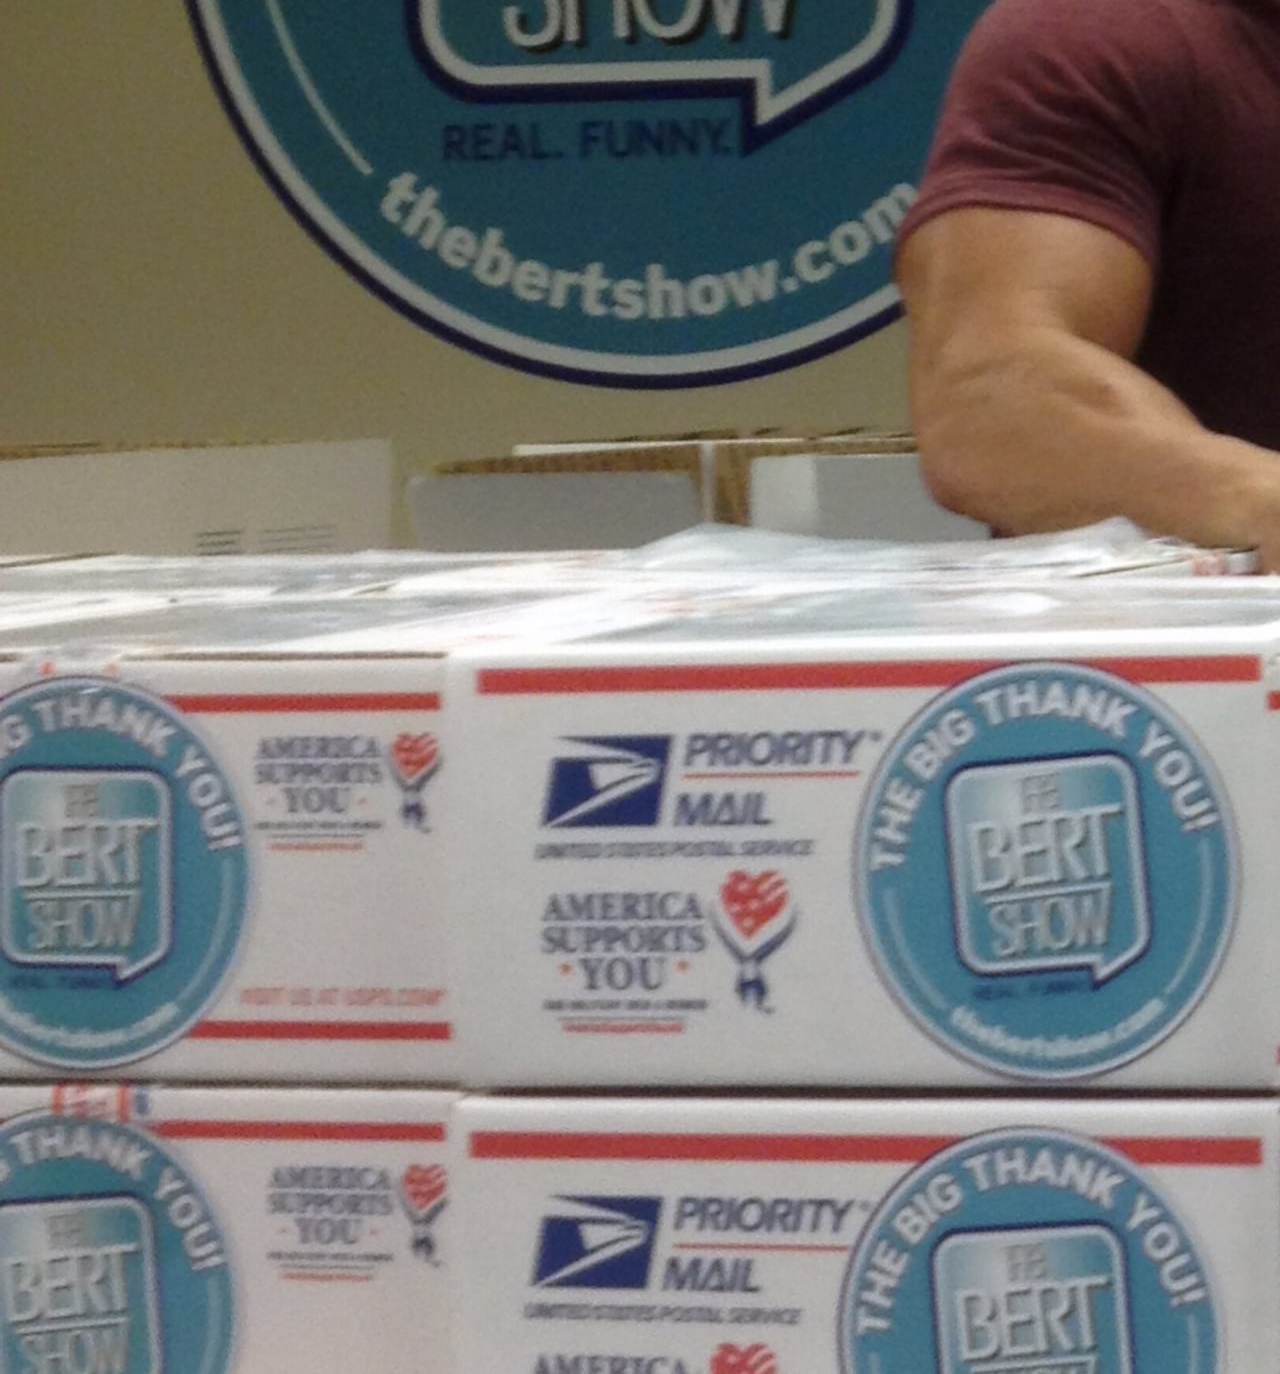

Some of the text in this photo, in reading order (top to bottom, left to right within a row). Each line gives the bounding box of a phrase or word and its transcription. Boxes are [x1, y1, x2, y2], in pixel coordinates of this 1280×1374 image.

[442, 117, 736, 162] REAL. FUNNY.
[381, 169, 919, 321] thebertshow.com
[32, 696, 176, 756] THANK
[174, 746, 244, 852] YOU!
[683, 729, 868, 767] PRIORITY
[871, 779, 925, 872] THE
[904, 708, 975, 781] BIG
[973, 679, 1139, 738] THANK
[1139, 722, 1222, 833] YOU!
[279, 787, 351, 814] YOU
[674, 792, 774, 827] MAIL
[15, 818, 160, 887] BERT
[970, 802, 1125, 892] BERT
[26, 890, 141, 950] SHOW
[543, 892, 703, 921] AMERICA
[989, 885, 1113, 957] SHOW
[541, 925, 707, 954] SUPPORTS
[578, 957, 668, 991] YOU
[9, 1126, 152, 1182] THANK
[155, 1168, 228, 1272] YOU!
[673, 1196, 856, 1234] PRIORITY
[293, 1217, 364, 1245] YOU
[857, 1239, 909, 1336] THE
[891, 1173, 964, 1247] BIG
[961, 1146, 1127, 1210] THANK
[1126, 1196, 1211, 1309] YOU!
[9, 1242, 141, 1324] BERT
[661, 1256, 760, 1293] MAIL
[954, 1275, 1113, 1363] BERT
